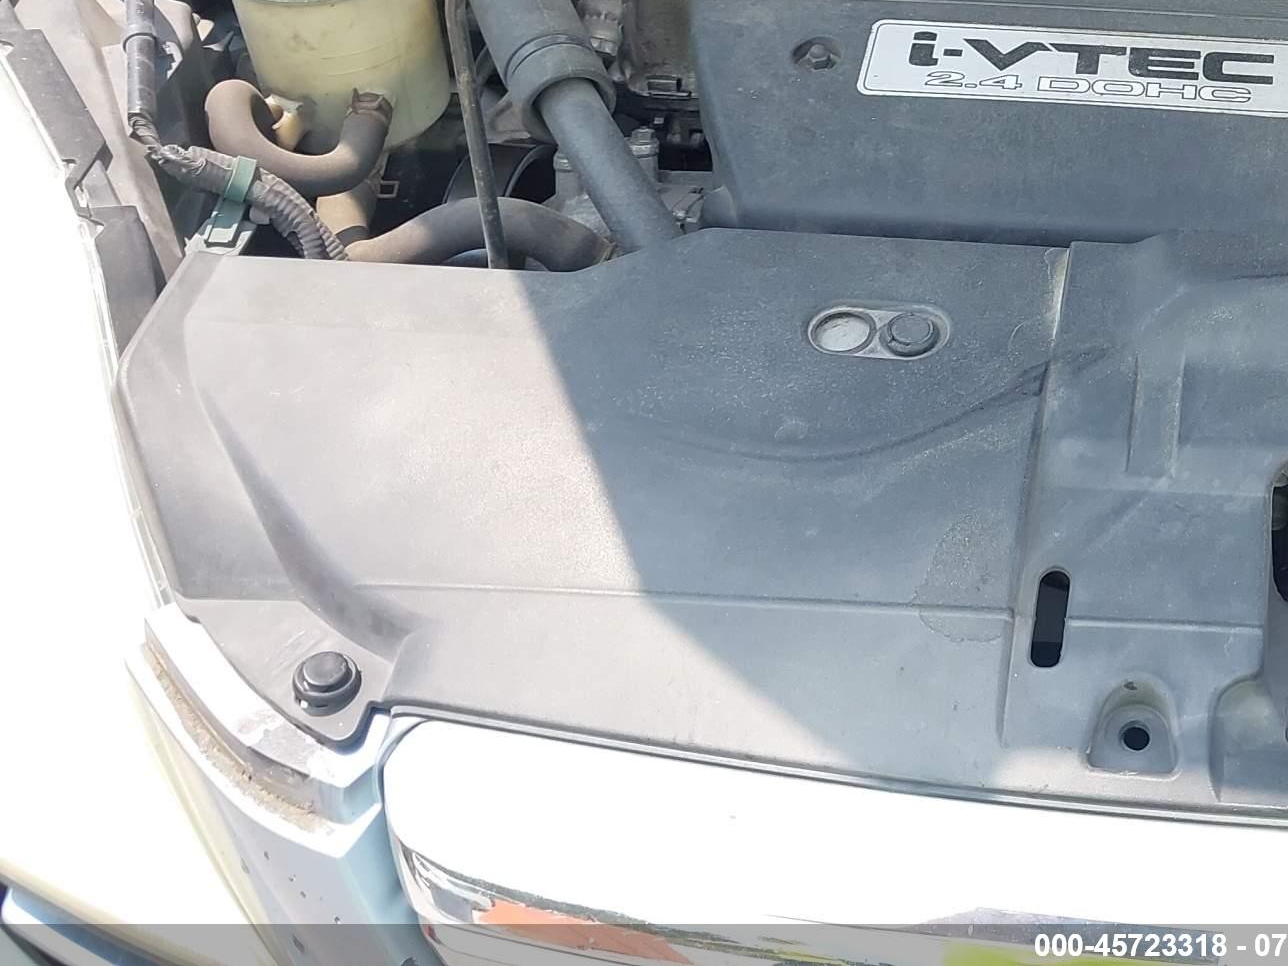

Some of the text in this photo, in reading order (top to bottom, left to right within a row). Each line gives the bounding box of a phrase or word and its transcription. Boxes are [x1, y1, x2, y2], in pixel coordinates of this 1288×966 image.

[907, 30, 1275, 85] i-VTEC
[924, 70, 1253, 103] 2.4 DOHC
